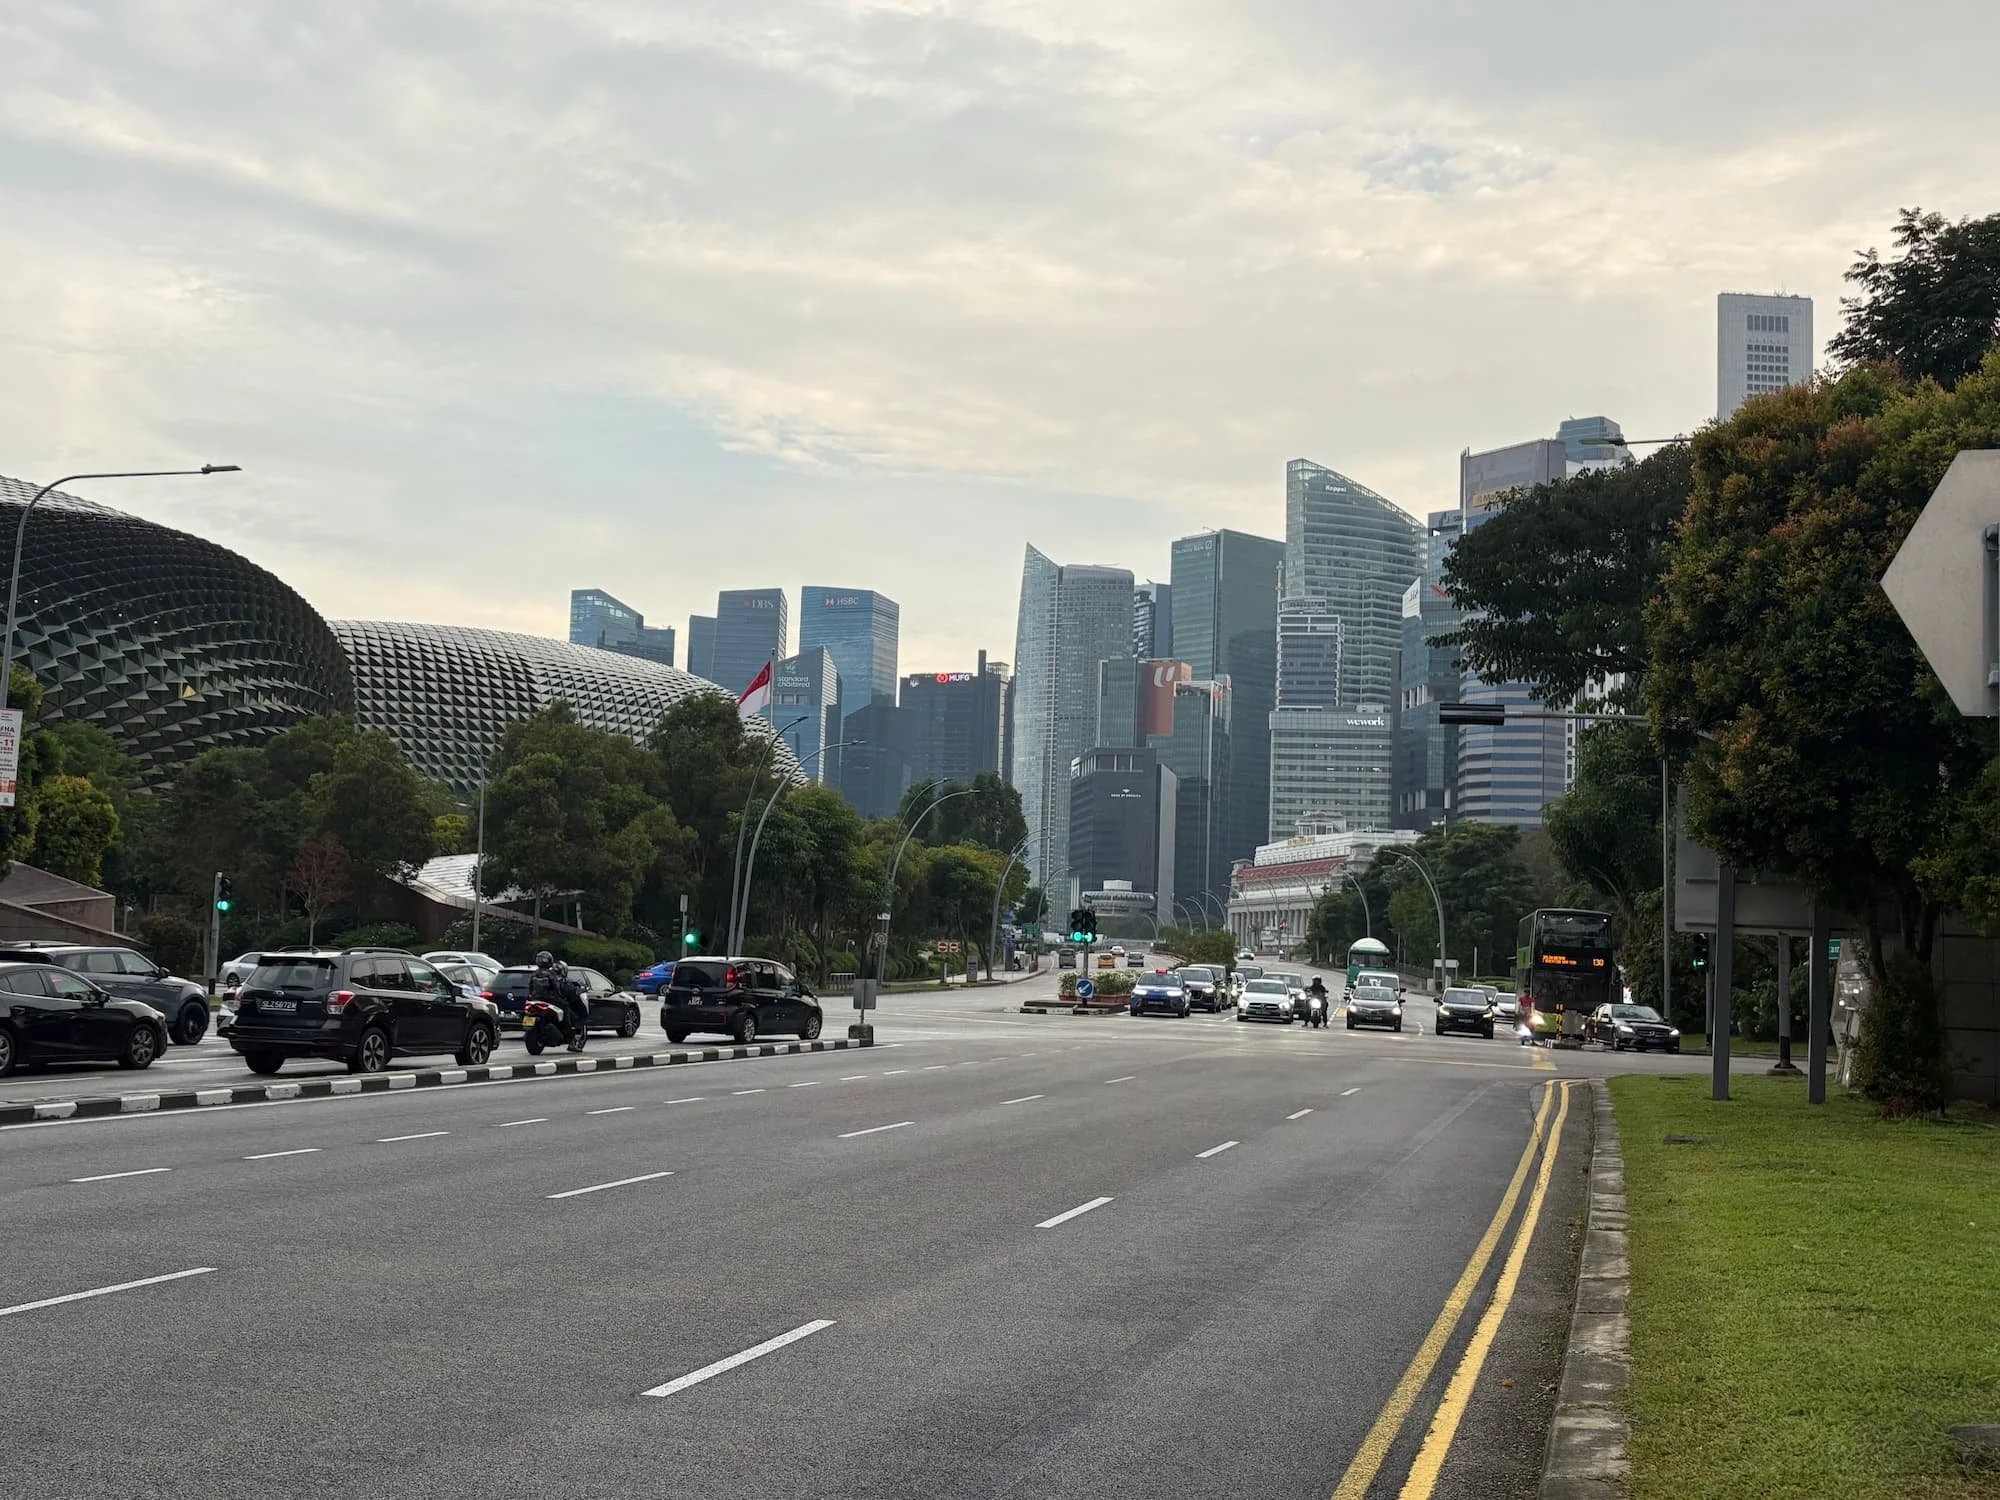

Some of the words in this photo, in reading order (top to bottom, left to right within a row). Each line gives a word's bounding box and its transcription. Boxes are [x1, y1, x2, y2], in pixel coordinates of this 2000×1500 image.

[752, 599, 775, 609] DBS
[836, 597, 859, 606] HSBC
[948, 674, 970, 682] MUFG
[1346, 716, 1385, 726] wework
[1592, 958, 1604, 967] 130
